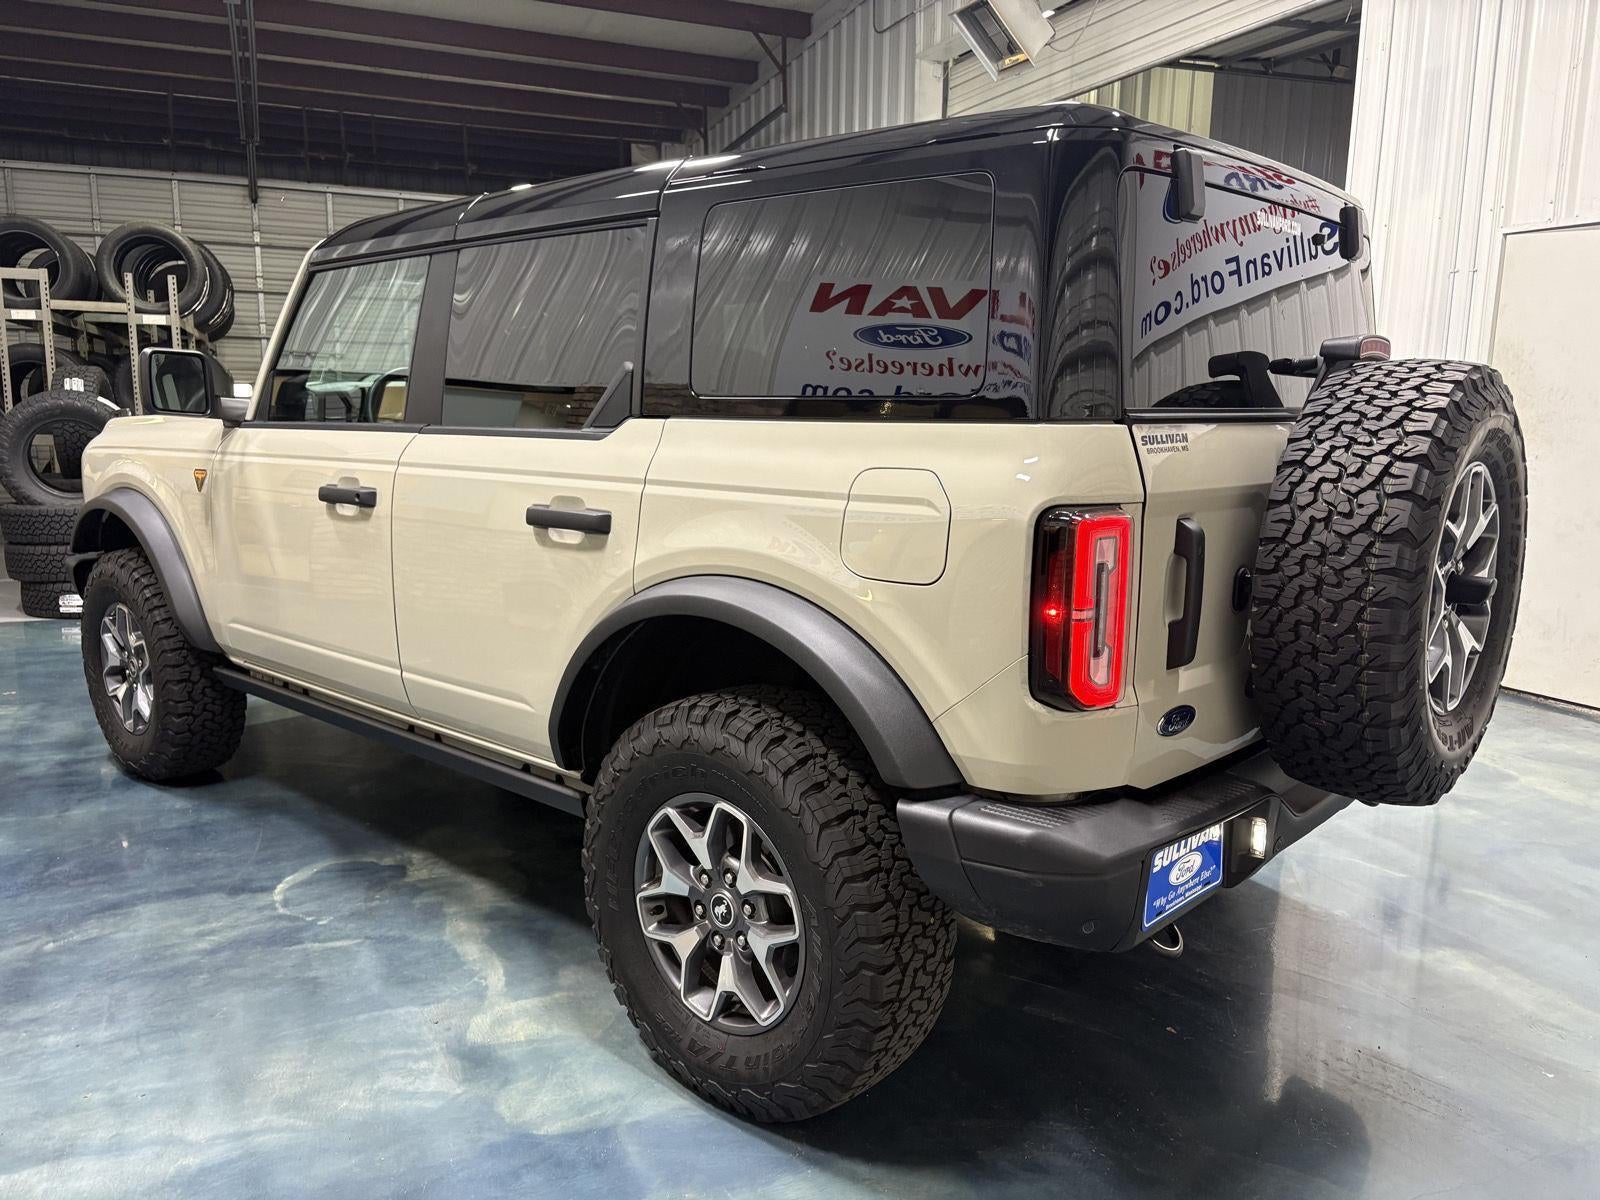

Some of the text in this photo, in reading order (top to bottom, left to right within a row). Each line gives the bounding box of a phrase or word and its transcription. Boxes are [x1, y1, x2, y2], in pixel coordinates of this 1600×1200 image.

[1141, 433, 1188, 446] SULLIVAN
[1152, 824, 1220, 874] SULLIVAN
[1175, 858, 1197, 881] Ford
